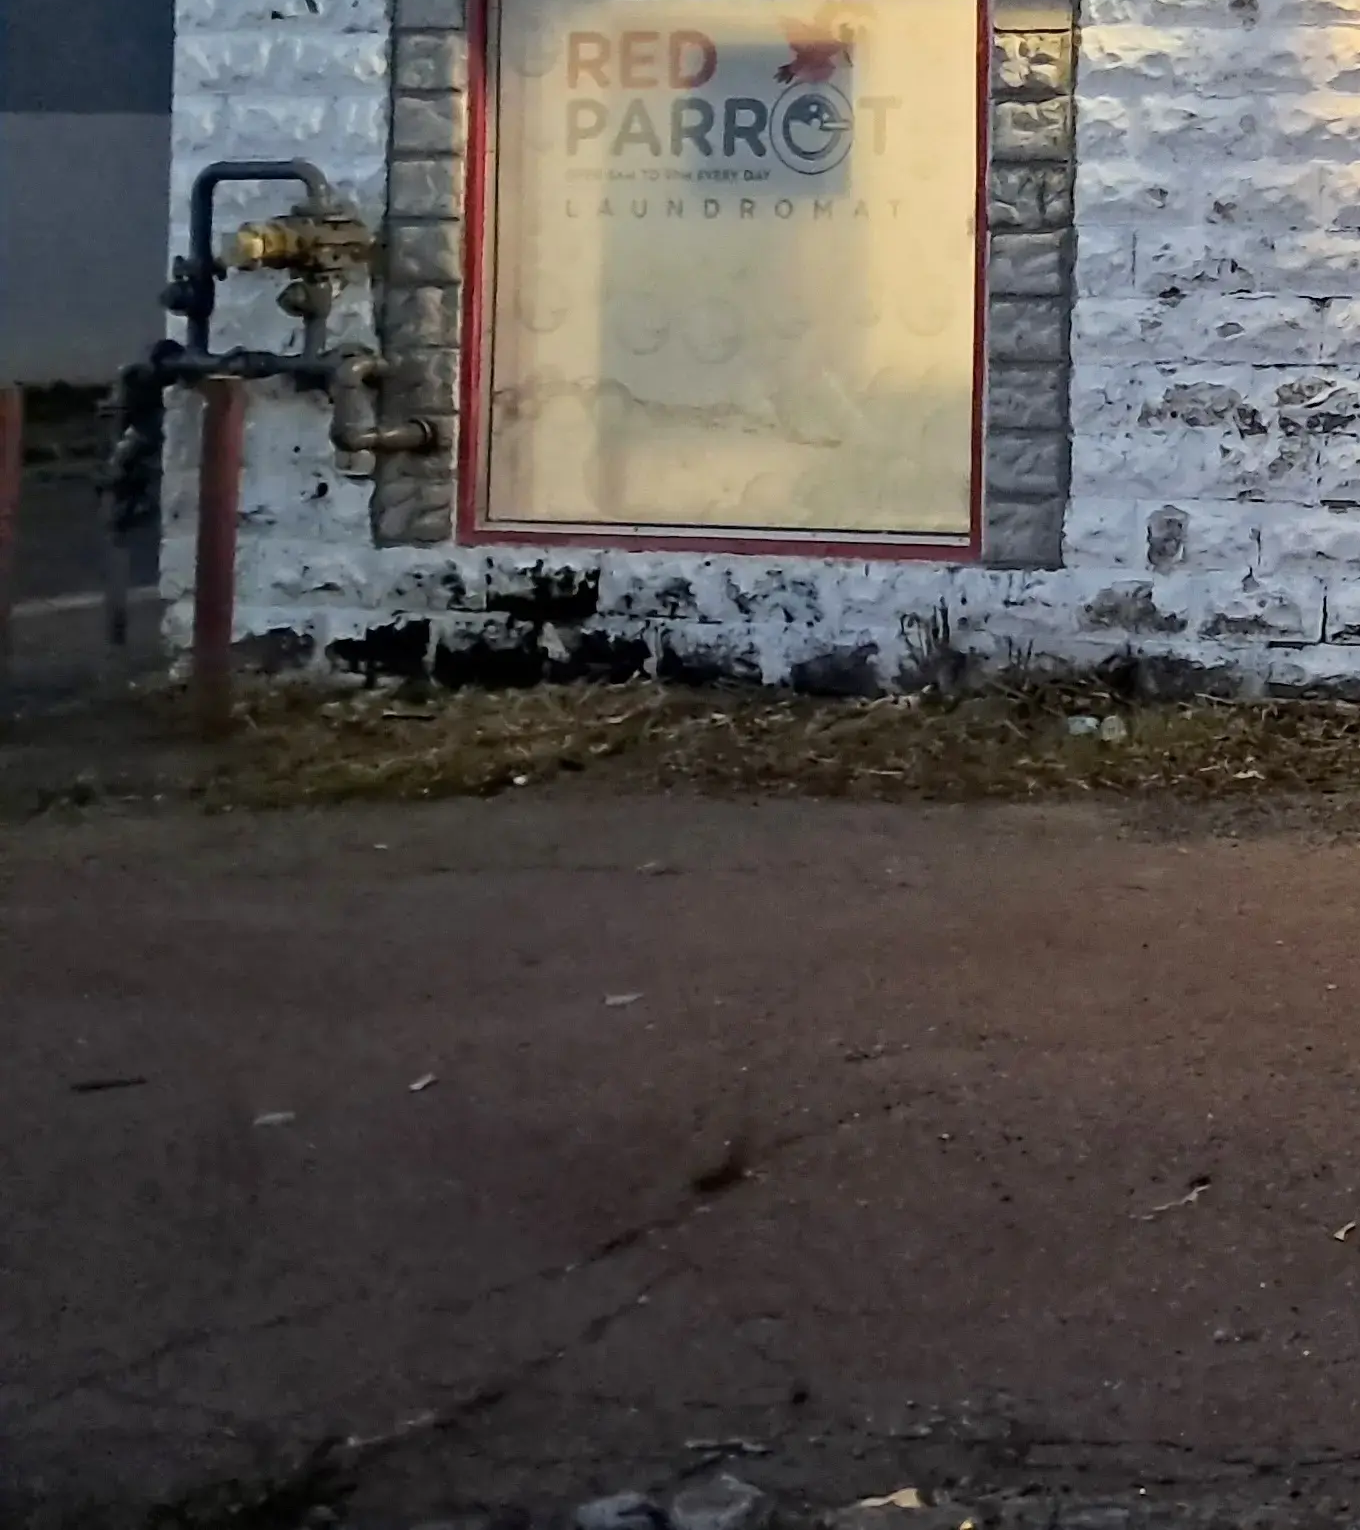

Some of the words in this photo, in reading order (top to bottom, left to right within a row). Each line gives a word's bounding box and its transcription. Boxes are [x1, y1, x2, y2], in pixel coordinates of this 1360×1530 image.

[565, 30, 718, 90] RED
[565, 87, 903, 168] PARROT
[565, 199, 902, 220] LAUNDROMAT
